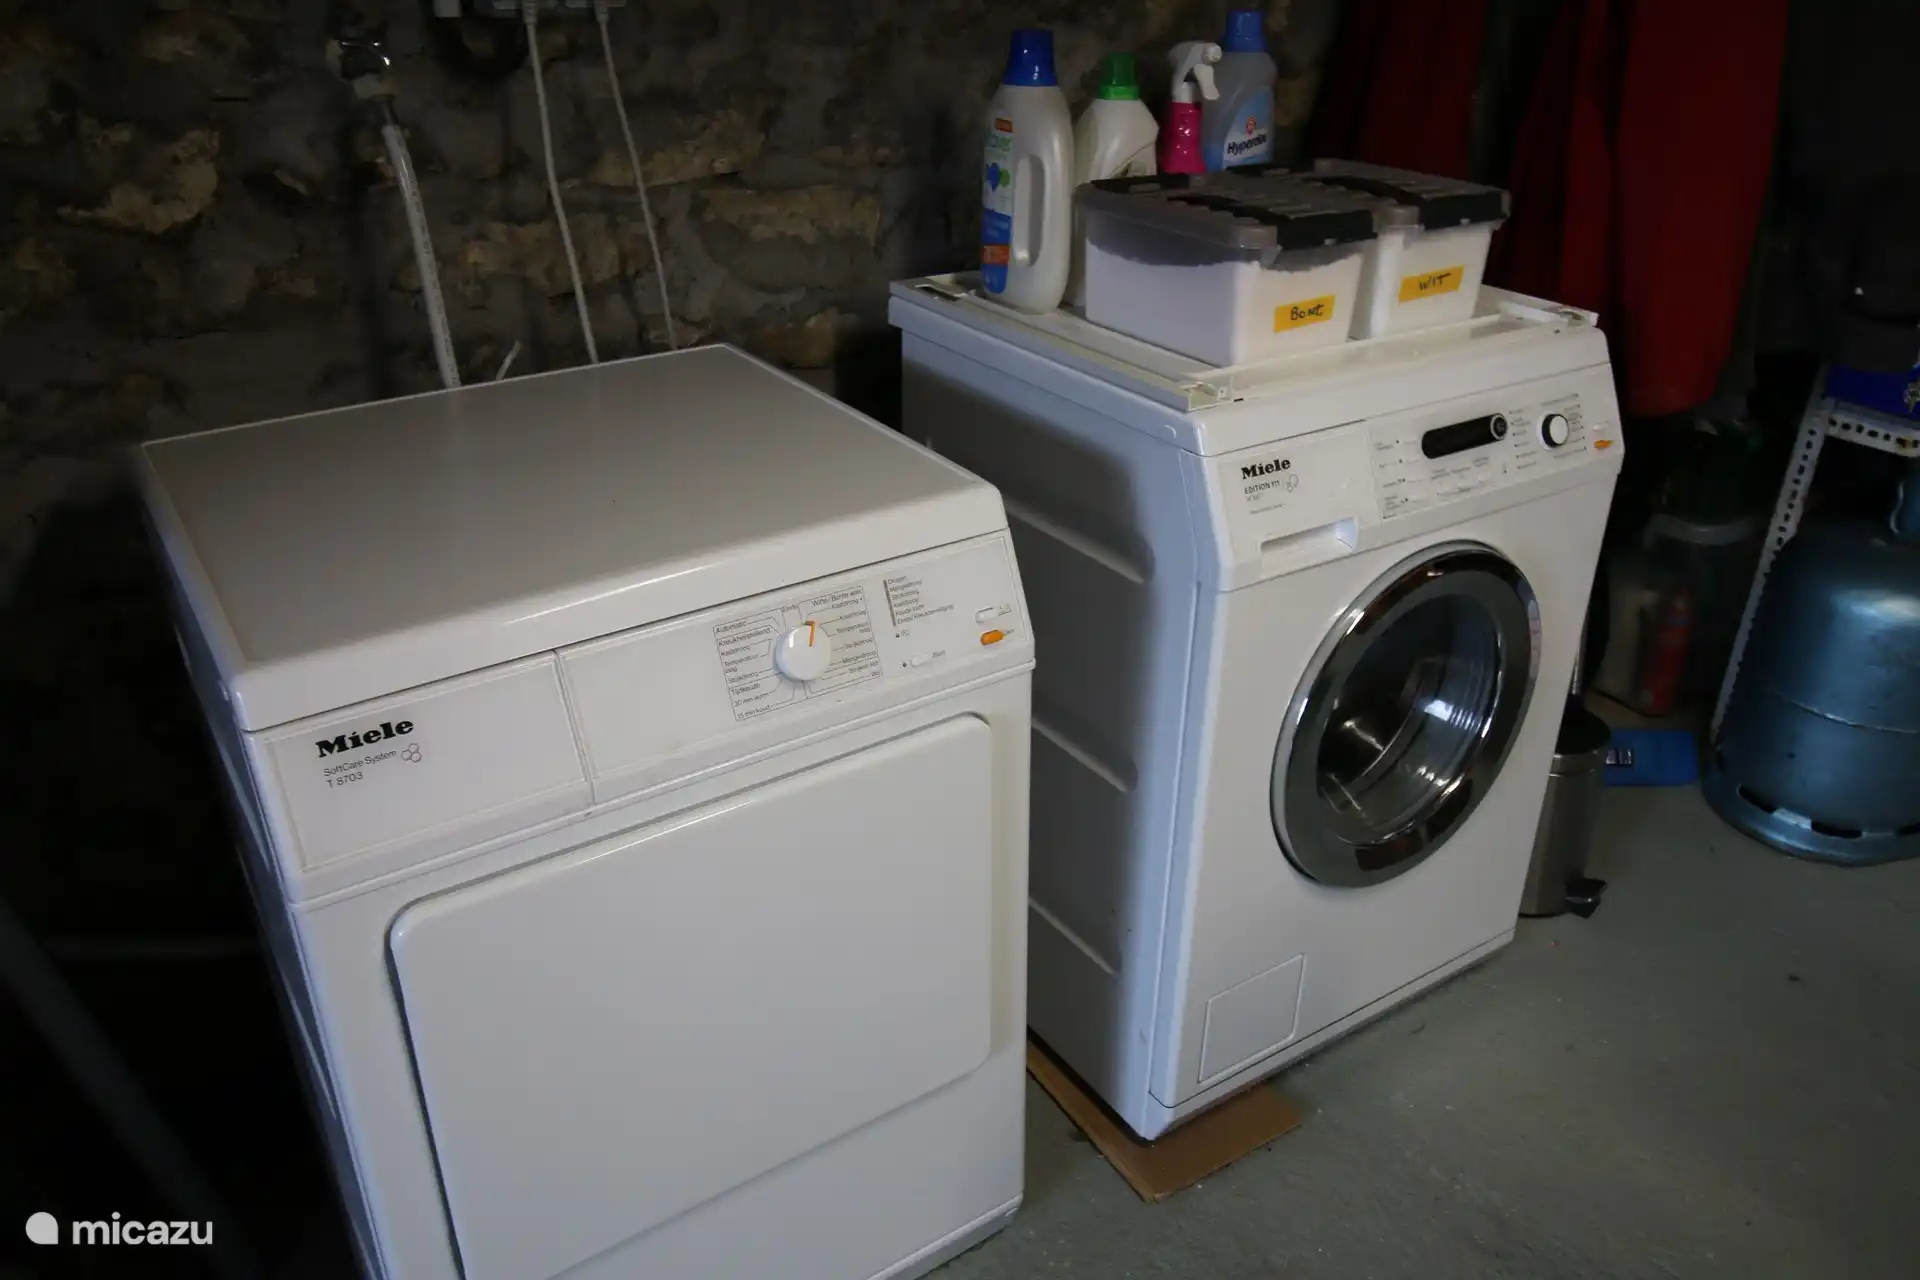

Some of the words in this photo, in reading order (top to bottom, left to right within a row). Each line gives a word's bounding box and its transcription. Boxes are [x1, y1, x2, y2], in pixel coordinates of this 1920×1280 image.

[1241, 459, 1291, 480] Miele
[1244, 482, 1271, 495] EDITION
[315, 720, 415, 759] Miele
[323, 759, 364, 777] SoftCare
[364, 750, 398, 765] System
[326, 779, 333, 788] T
[336, 771, 364, 786] 8703
